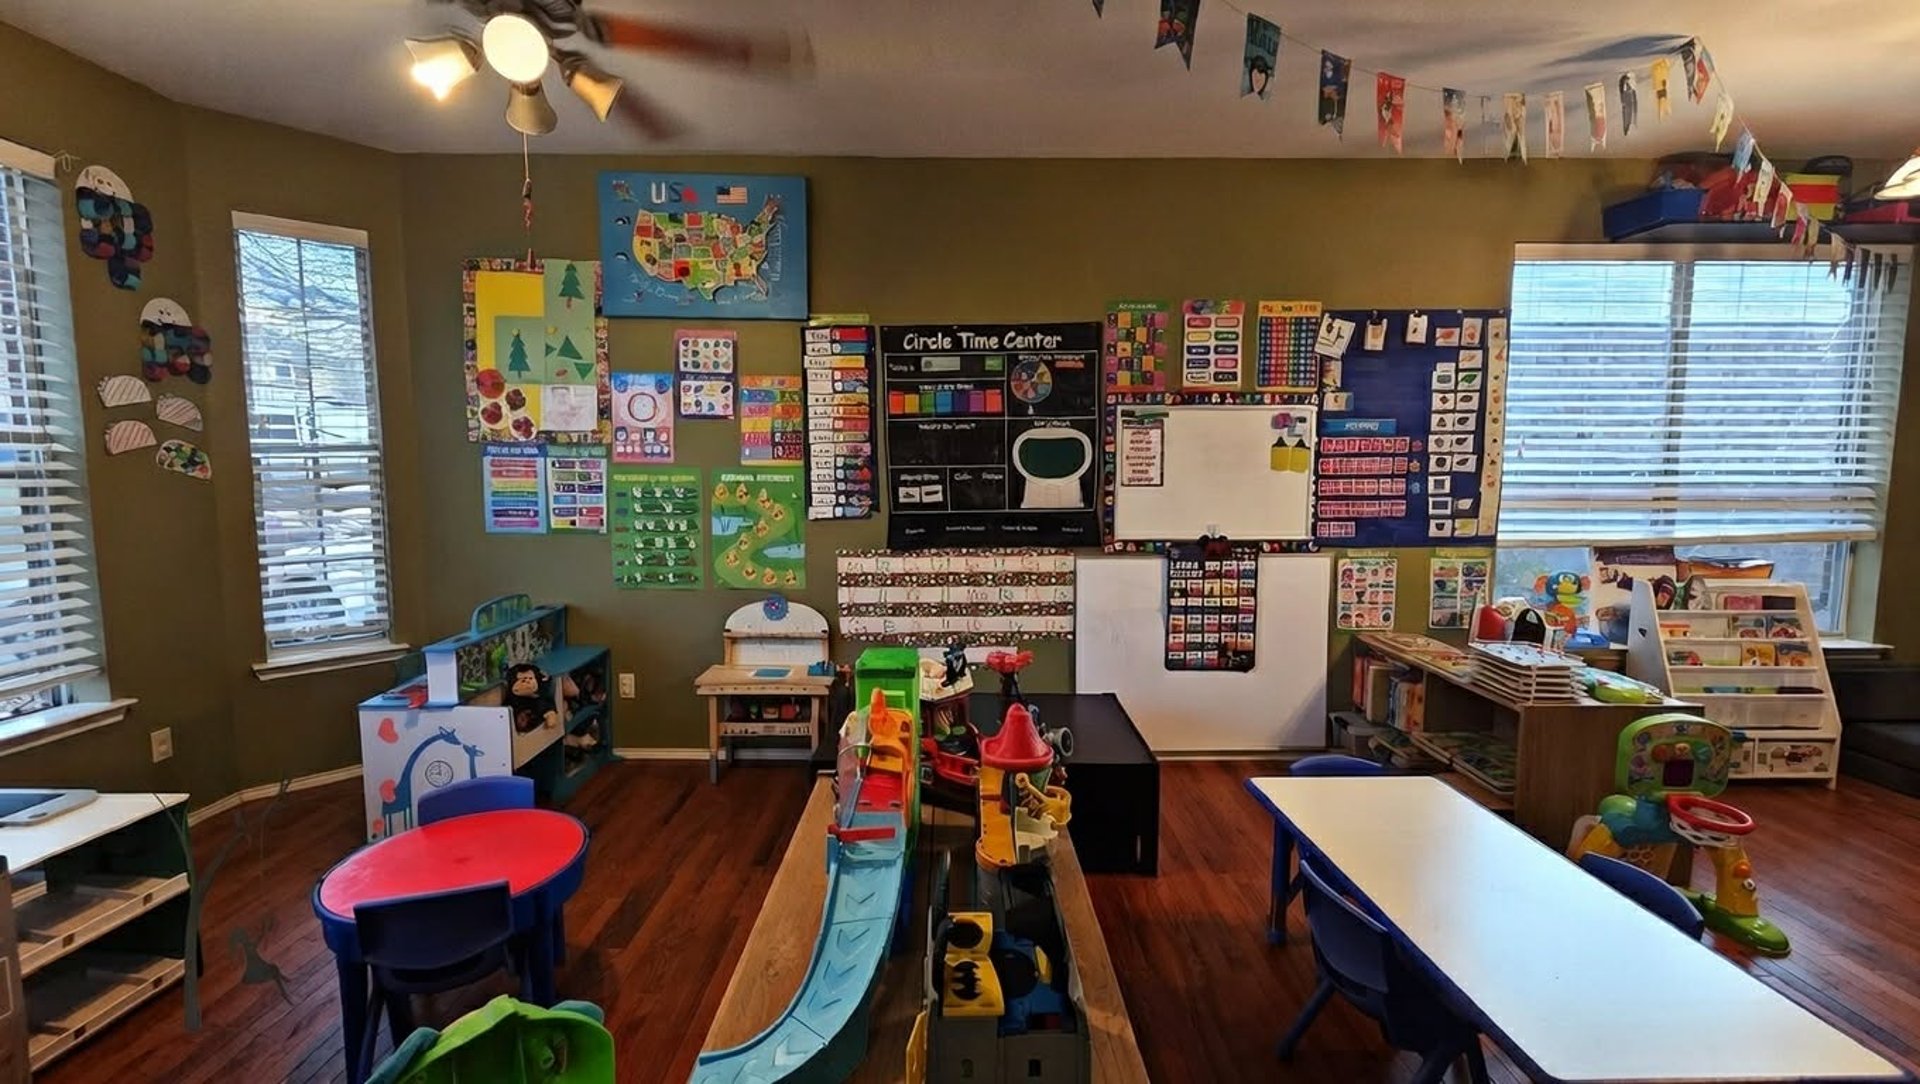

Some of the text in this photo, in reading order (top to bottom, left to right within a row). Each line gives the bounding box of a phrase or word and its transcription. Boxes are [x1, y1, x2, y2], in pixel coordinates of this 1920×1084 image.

[903, 330, 1062, 350] Circle Time Center
